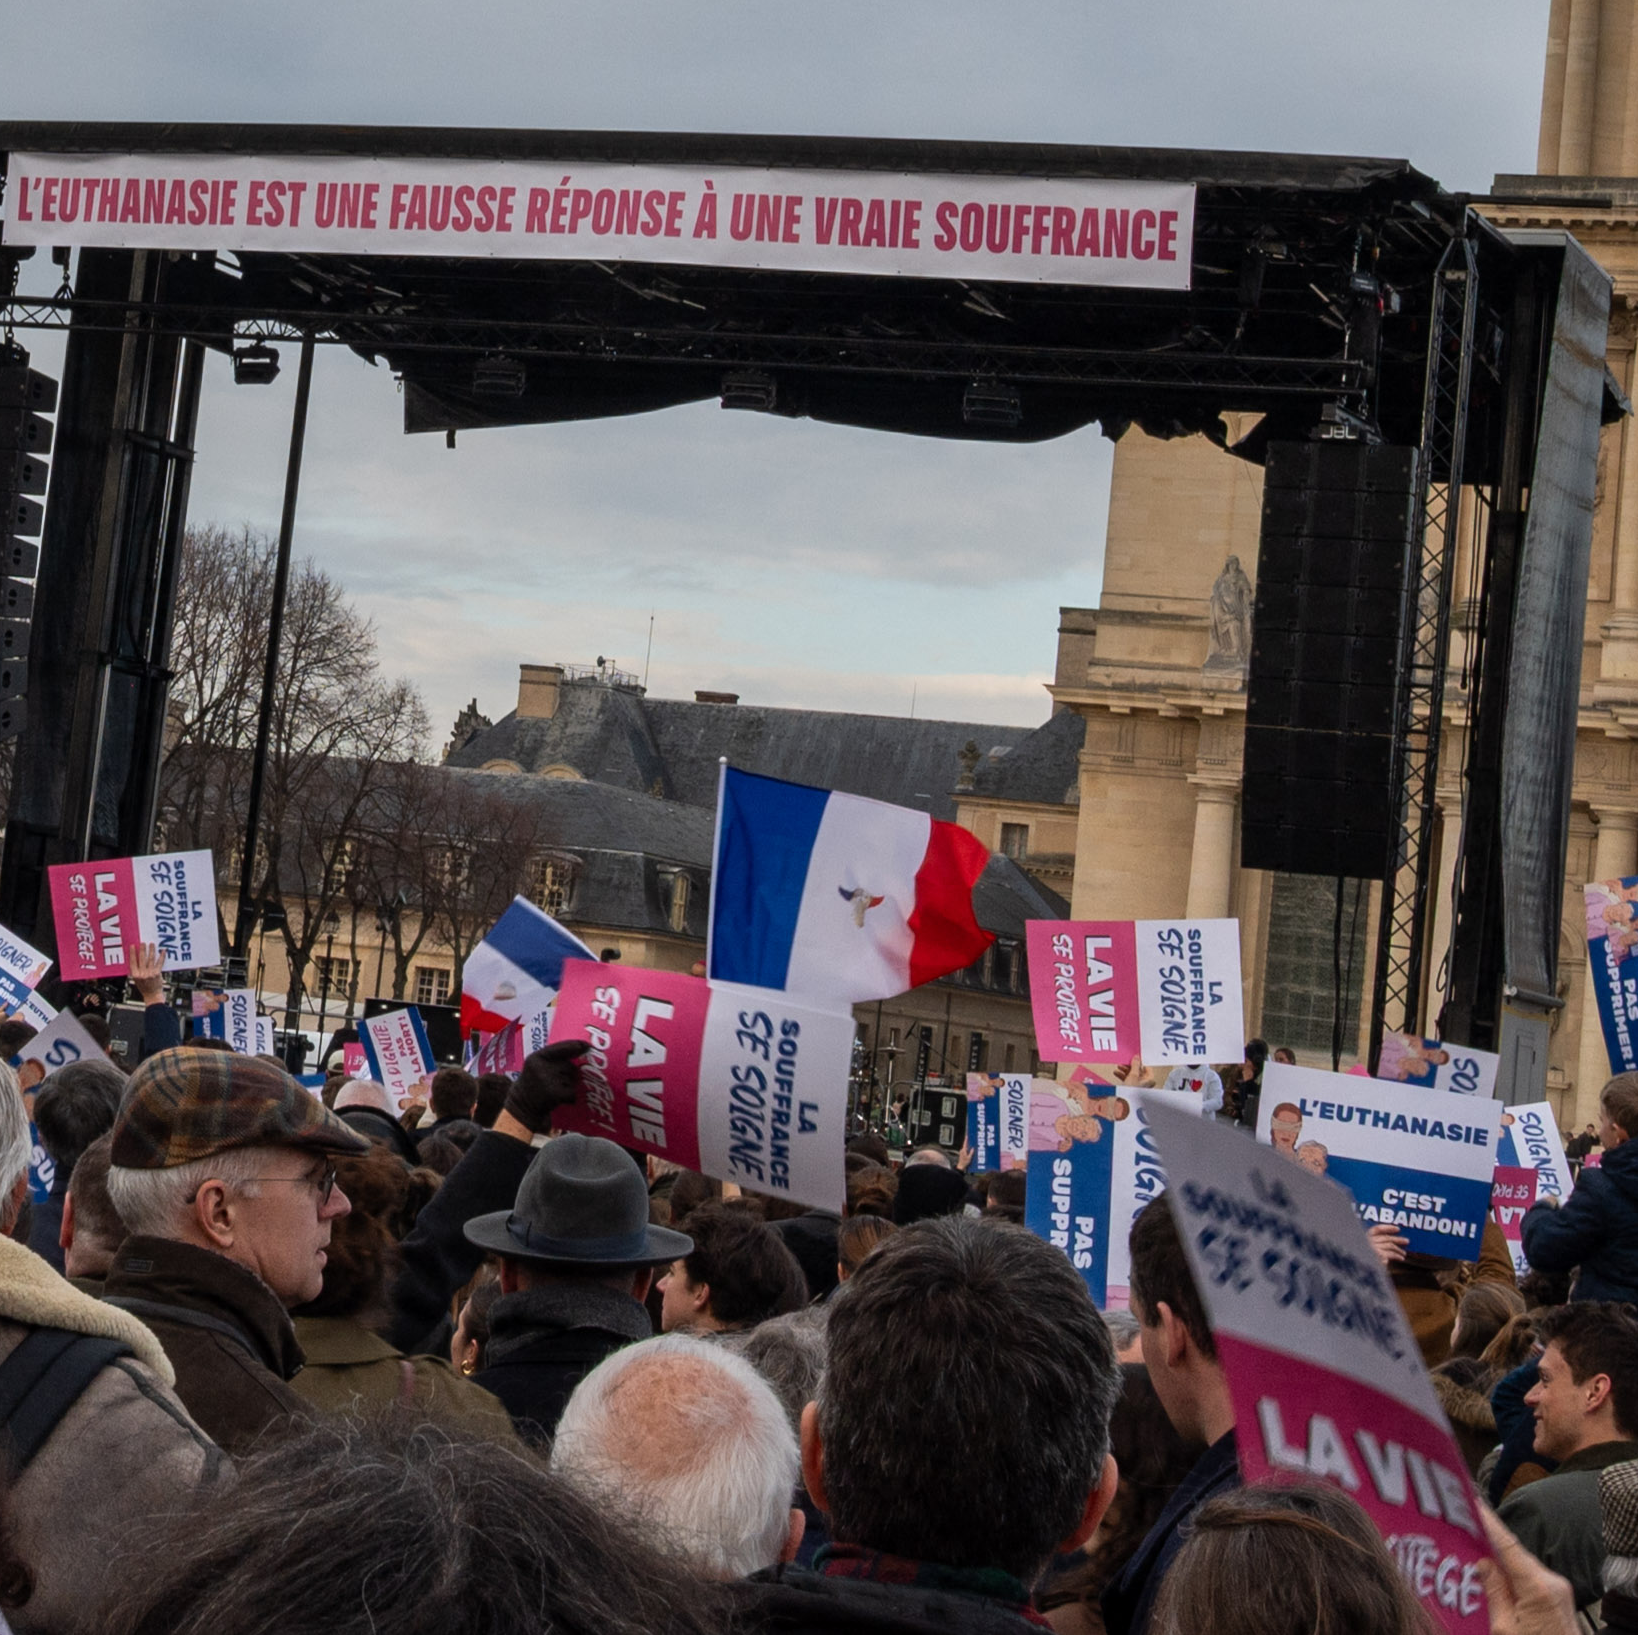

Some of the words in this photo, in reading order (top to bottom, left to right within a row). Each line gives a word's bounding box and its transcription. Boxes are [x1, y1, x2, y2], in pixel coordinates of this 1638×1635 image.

[17, 177, 238, 225] L'EUTHANASIE
[246, 180, 307, 227] EST
[315, 182, 380, 229] UNE
[389, 183, 516, 232] FAUSSE
[525, 176, 686, 237] RÉPONSE
[693, 179, 717, 239] À
[729, 193, 802, 243] UNE
[814, 196, 922, 249] VRAIE
[934, 201, 1178, 261] SOUFFRANCE
[1321, 425, 1357, 439] JBL
[69, 873, 88, 895] SE
[94, 871, 119, 913] LA
[150, 861, 172, 886] SE
[173, 860, 192, 962] SOUFFRANCE
[190, 900, 204, 921] LA
[100, 913, 126, 967] VIE
[1051, 933, 1074, 962] SE
[1083, 934, 1114, 986] LA
[1157, 927, 1184, 961] SE
[590, 985, 621, 1026] SE
[1187, 928, 1207, 1056] SOUFFRANCE
[1209, 981, 1223, 1006] LA
[400, 1023, 419, 1057] MORT
[626, 994, 675, 1069] LA
[736, 1009, 774, 1055] SE
[1086, 988, 1119, 1053] VIE
[395, 1036, 407, 1058] PAS
[412, 1054, 422, 1074] LA
[393, 1079, 407, 1096] LA
[770, 1018, 801, 1191] SOUFFRANCE
[626, 1077, 668, 1150] VIE
[797, 1101, 819, 1135] LA
[975, 1102, 987, 1164] SUPPRIMER
[1299, 1098, 1489, 1147] L'EUTHANASIE
[986, 1123, 996, 1147] PAS
[1049, 1158, 1072, 1250] SUPPR
[1382, 1188, 1447, 1214] C'EST
[1073, 1216, 1094, 1270] PAS
[1256, 1396, 1360, 1492] LA
[1354, 1427, 1481, 1539] VIE
